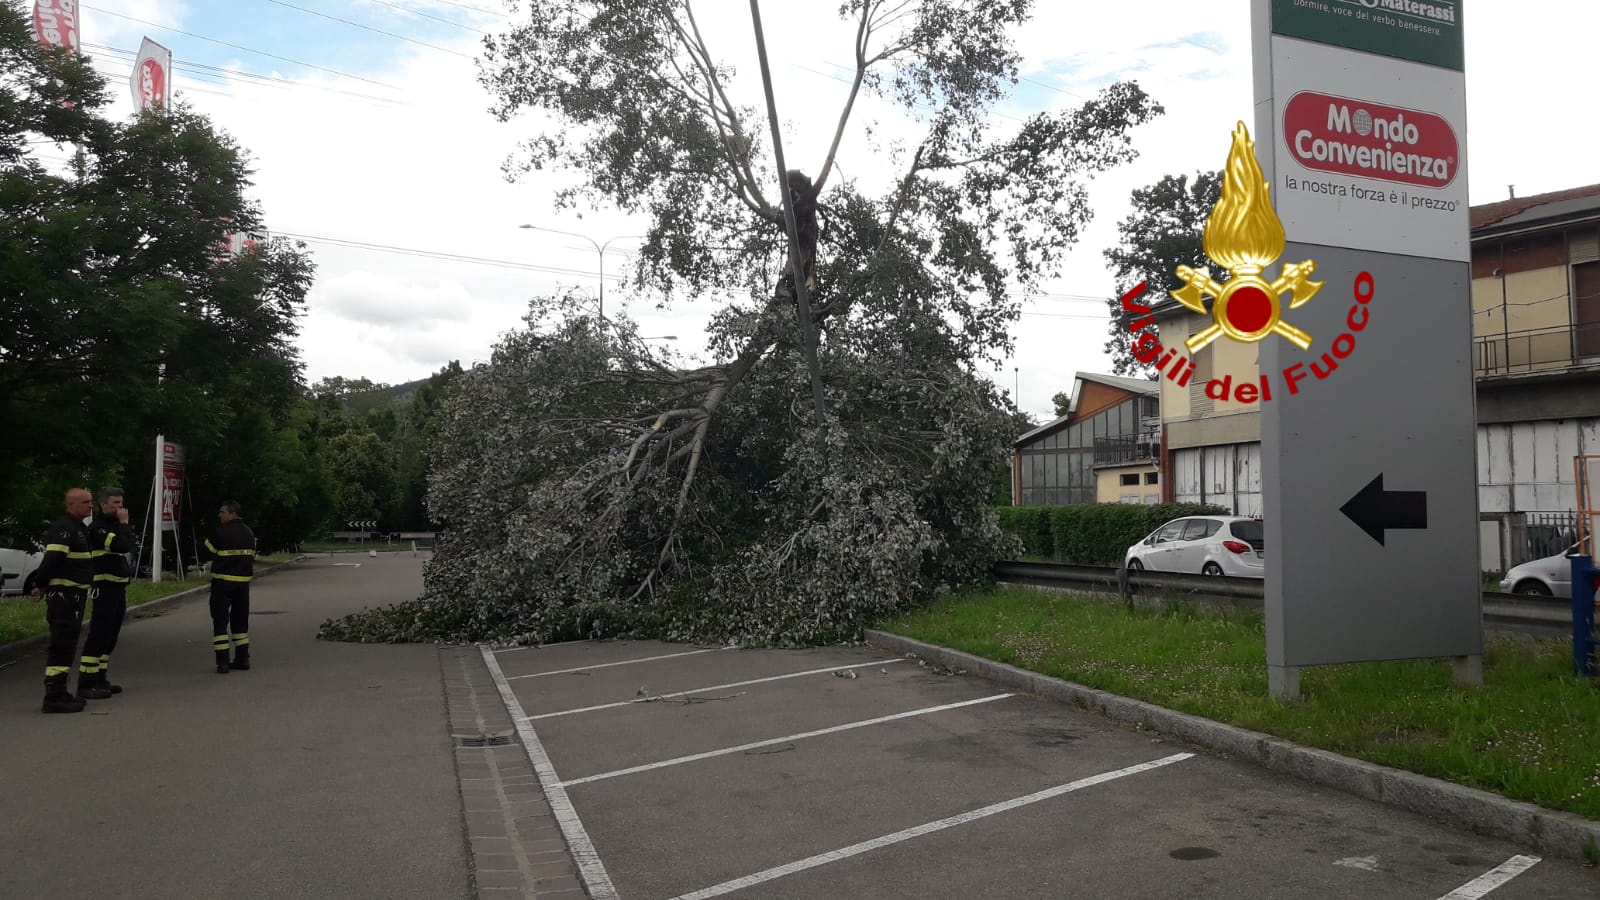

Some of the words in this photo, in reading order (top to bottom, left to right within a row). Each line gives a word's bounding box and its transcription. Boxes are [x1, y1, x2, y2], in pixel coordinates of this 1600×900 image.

[1332, 6, 1353, 17] voce
[1356, 9, 1369, 20] del
[1372, 15, 1396, 26] verbo
[1398, 18, 1440, 36] benessere
[1327, 103, 1419, 145] Mondo
[1295, 129, 1448, 180] Convenienza
[1285, 174, 1298, 190] la
[1302, 178, 1347, 196] nostra
[1351, 184, 1385, 202] forza
[1389, 190, 1398, 204] è
[1402, 191, 1408, 205] il
[1411, 196, 1456, 212] prezzo
